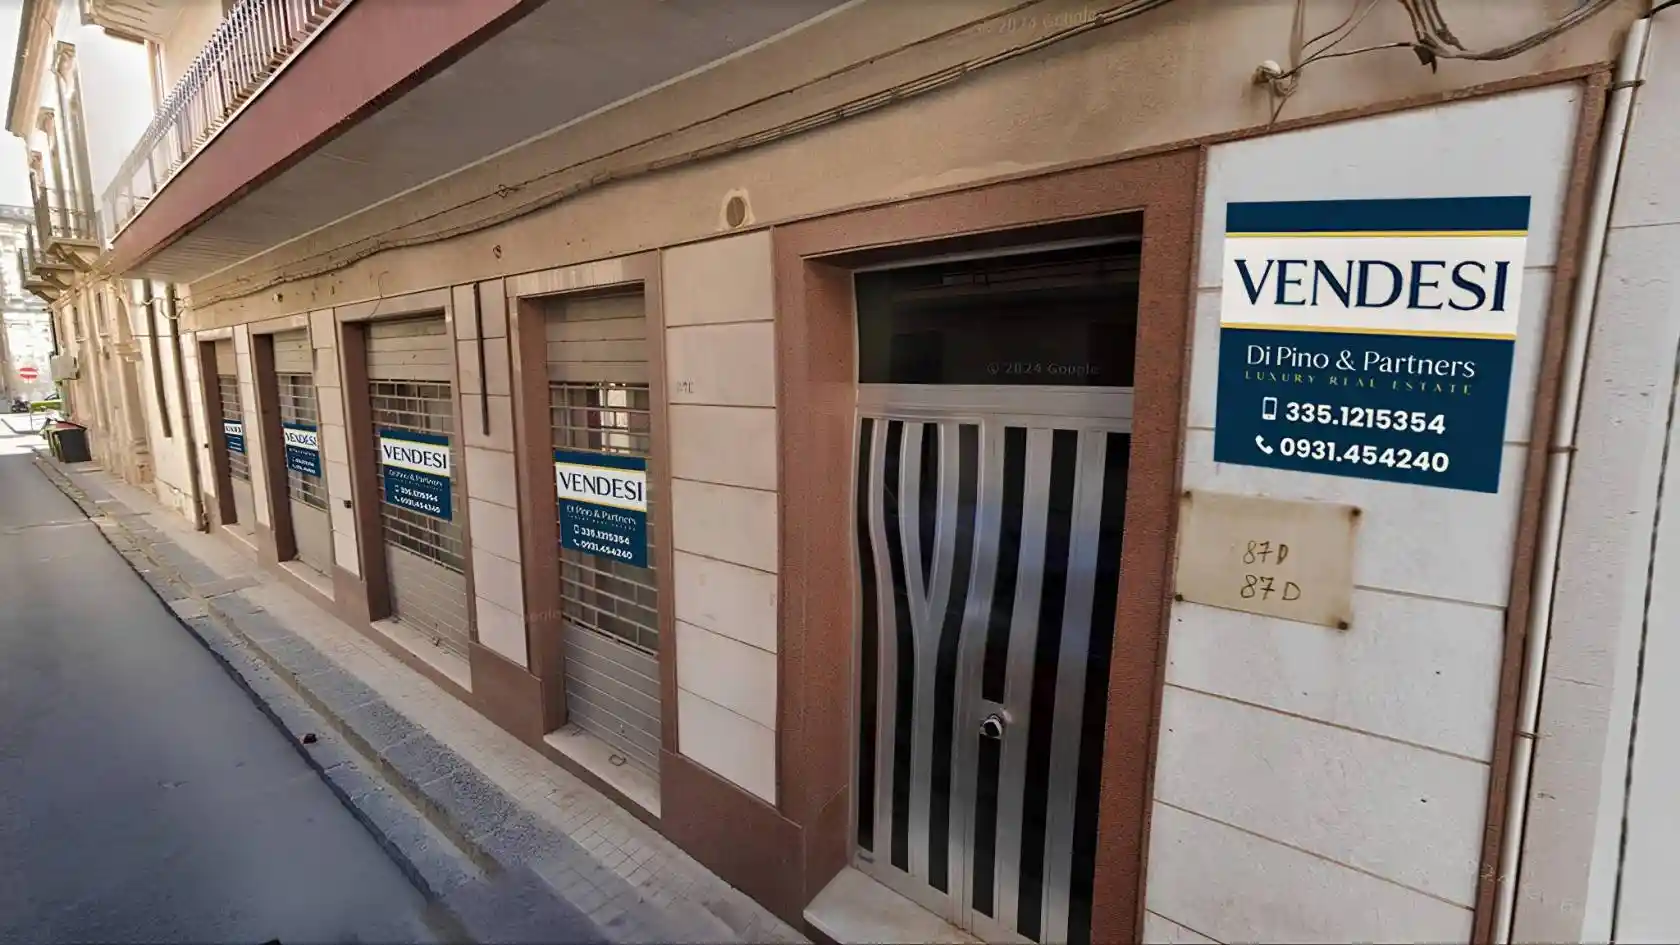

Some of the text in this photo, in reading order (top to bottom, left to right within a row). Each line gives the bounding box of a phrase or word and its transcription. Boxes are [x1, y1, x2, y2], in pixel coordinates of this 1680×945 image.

[1234, 259, 1510, 312] VENDESI
[1247, 344, 1476, 378] Di Pino & Partners
[1285, 401, 1446, 435] 335.1215354
[383, 444, 447, 470] VENDESI
[1280, 436, 1450, 473] 0931.454240
[559, 472, 643, 501] VENDESI
